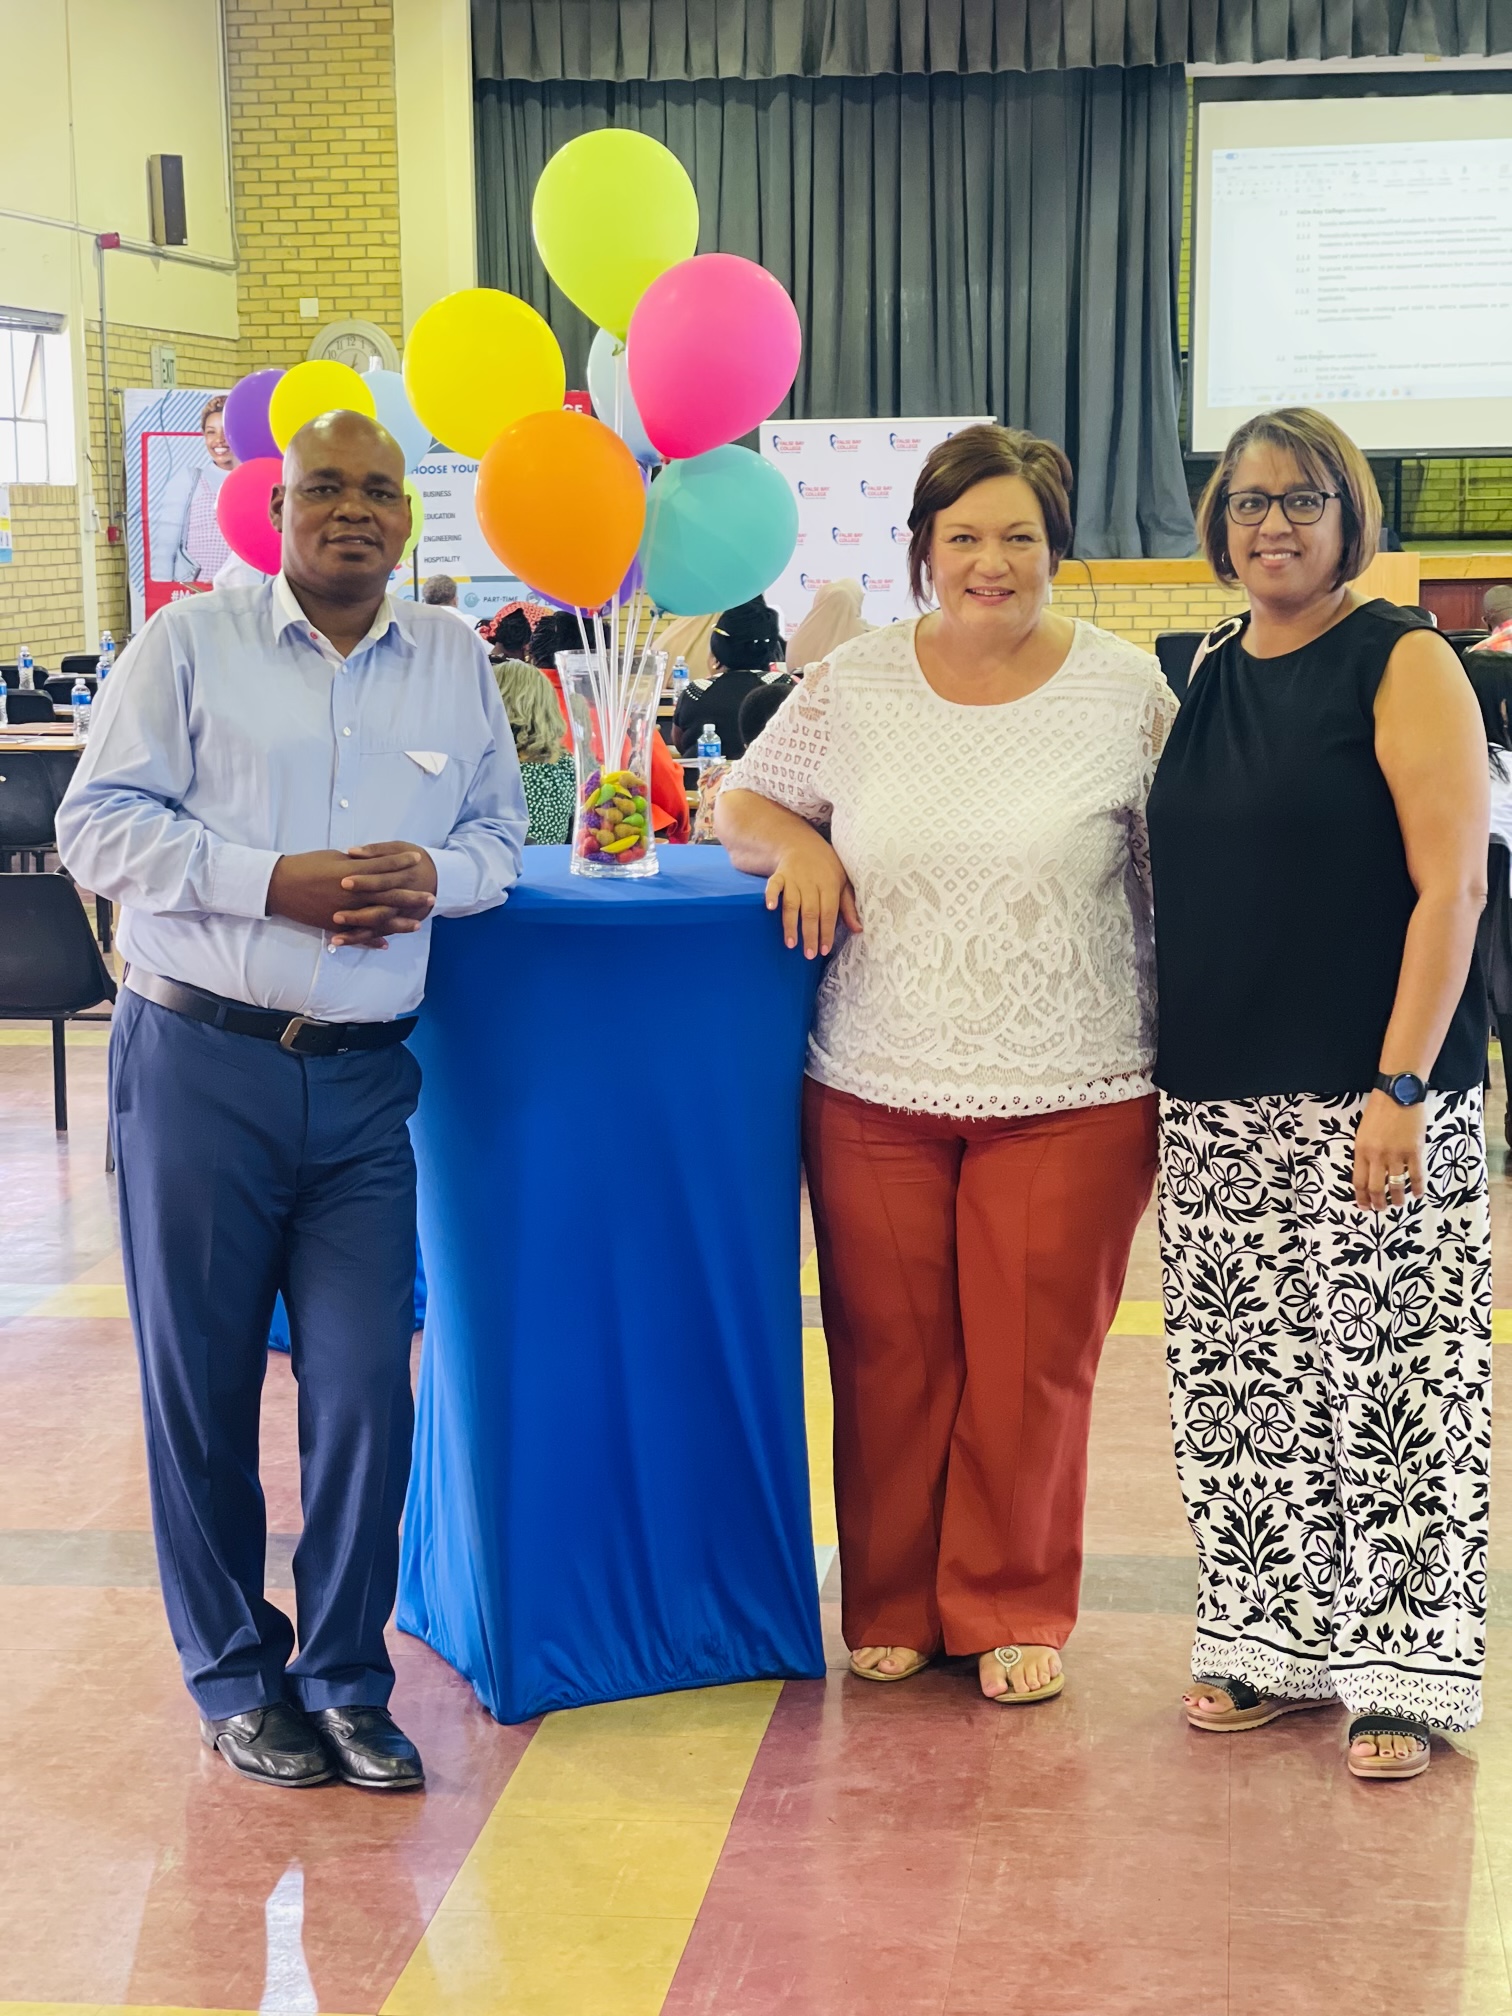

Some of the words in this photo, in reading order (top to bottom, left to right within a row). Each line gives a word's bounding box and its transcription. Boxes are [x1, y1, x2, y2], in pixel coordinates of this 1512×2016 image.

[345, 335, 356, 346] 12
[327, 349, 337, 360] 10
[411, 465, 447, 475] HOOSE
[423, 490, 452, 498] BUSINESS
[423, 512, 456, 520] EDUCATION
[423, 534, 462, 543] ENGINEERING
[423, 555, 461, 563] HOSPITALITY
[483, 595, 519, 603] PART-TIME
